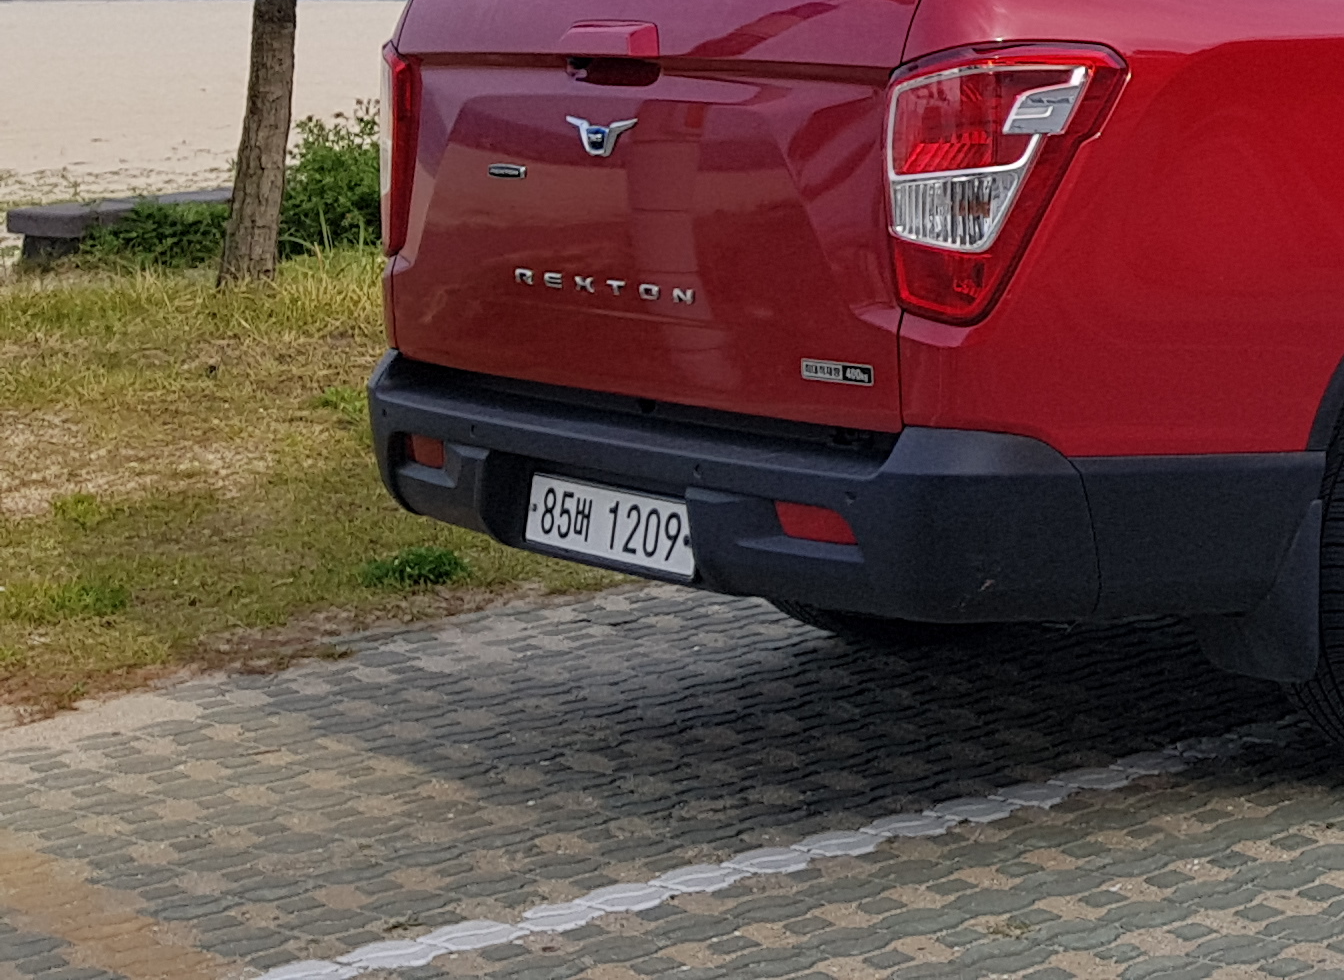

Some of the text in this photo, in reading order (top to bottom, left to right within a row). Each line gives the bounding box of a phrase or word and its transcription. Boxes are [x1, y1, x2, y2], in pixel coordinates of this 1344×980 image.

[514, 268, 695, 305] REXTON
[540, 486, 683, 562] 85버 1209
